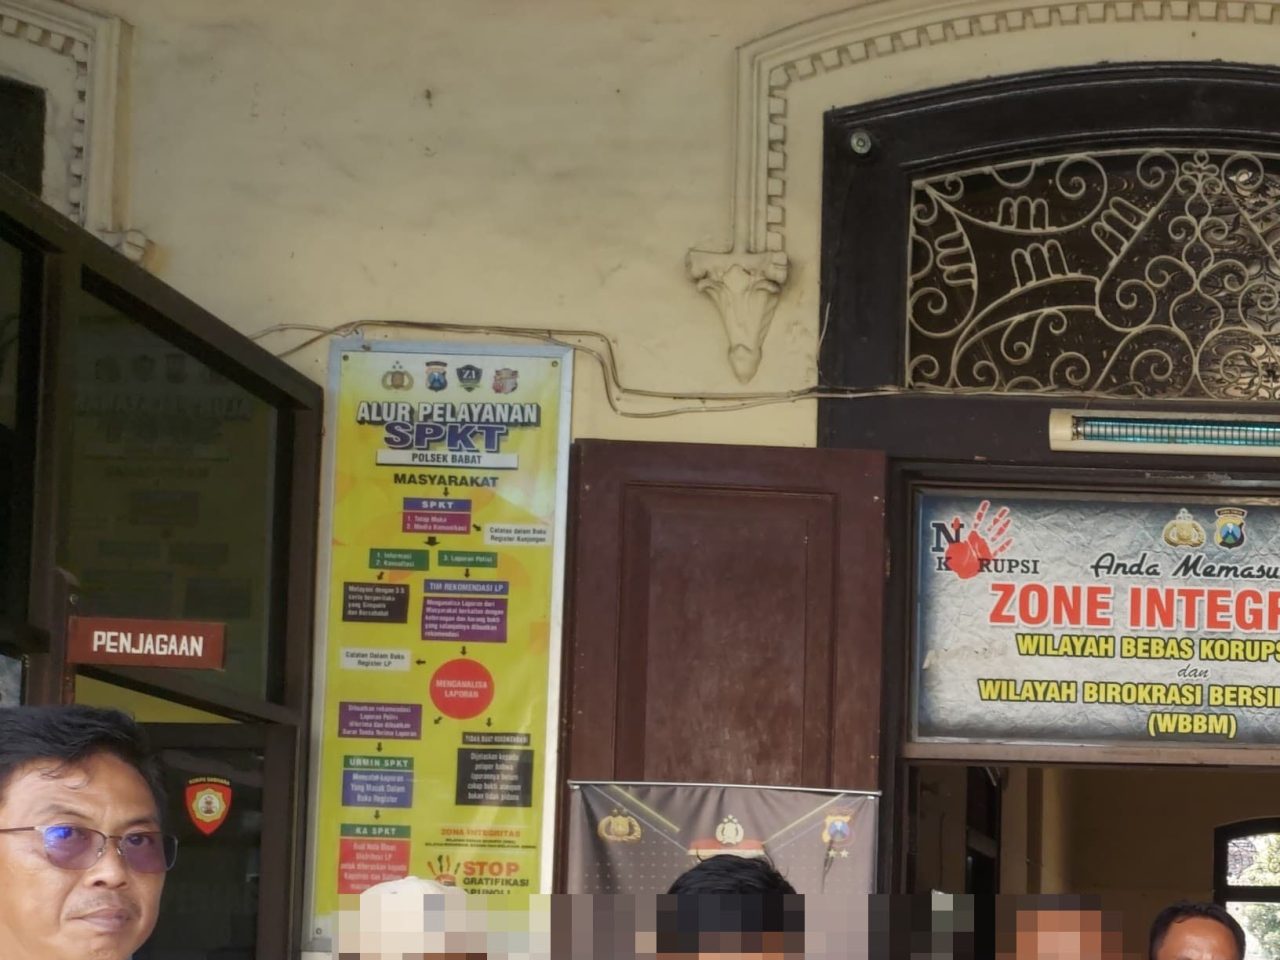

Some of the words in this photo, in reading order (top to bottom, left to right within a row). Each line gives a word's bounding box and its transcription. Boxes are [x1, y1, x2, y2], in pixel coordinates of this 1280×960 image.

[357, 402, 411, 424] ALUR
[419, 403, 539, 425] PELAYANAN
[384, 421, 507, 451] SPKT
[411, 453, 449, 464] POLSEK
[451, 454, 482, 465] BABAT
[393, 473, 499, 488] MASYARAKAT
[421, 500, 454, 509] SPKT
[936, 557, 1040, 574] KRUPSI
[1090, 553, 1160, 578] Anda
[444, 583, 493, 592] REKOMENDASI
[988, 583, 1112, 626] ZONE
[92, 630, 204, 657] PENJAGAAN
[1015, 634, 1115, 658] WILAYAH
[1121, 636, 1193, 660] BEBAS
[1177, 664, 1209, 679] dan
[978, 679, 1077, 703] WILAYAH
[1083, 681, 1203, 706] BIROKRASI
[1147, 712, 1238, 738] (WBBM)
[384, 759, 409, 768] SPKT
[371, 827, 396, 835] SPKT
[441, 828, 465, 836] ZONA
[466, 829, 521, 838] INTEGRITAS
[463, 860, 520, 877] STOP
[462, 876, 530, 887] GRATIFIKASI
